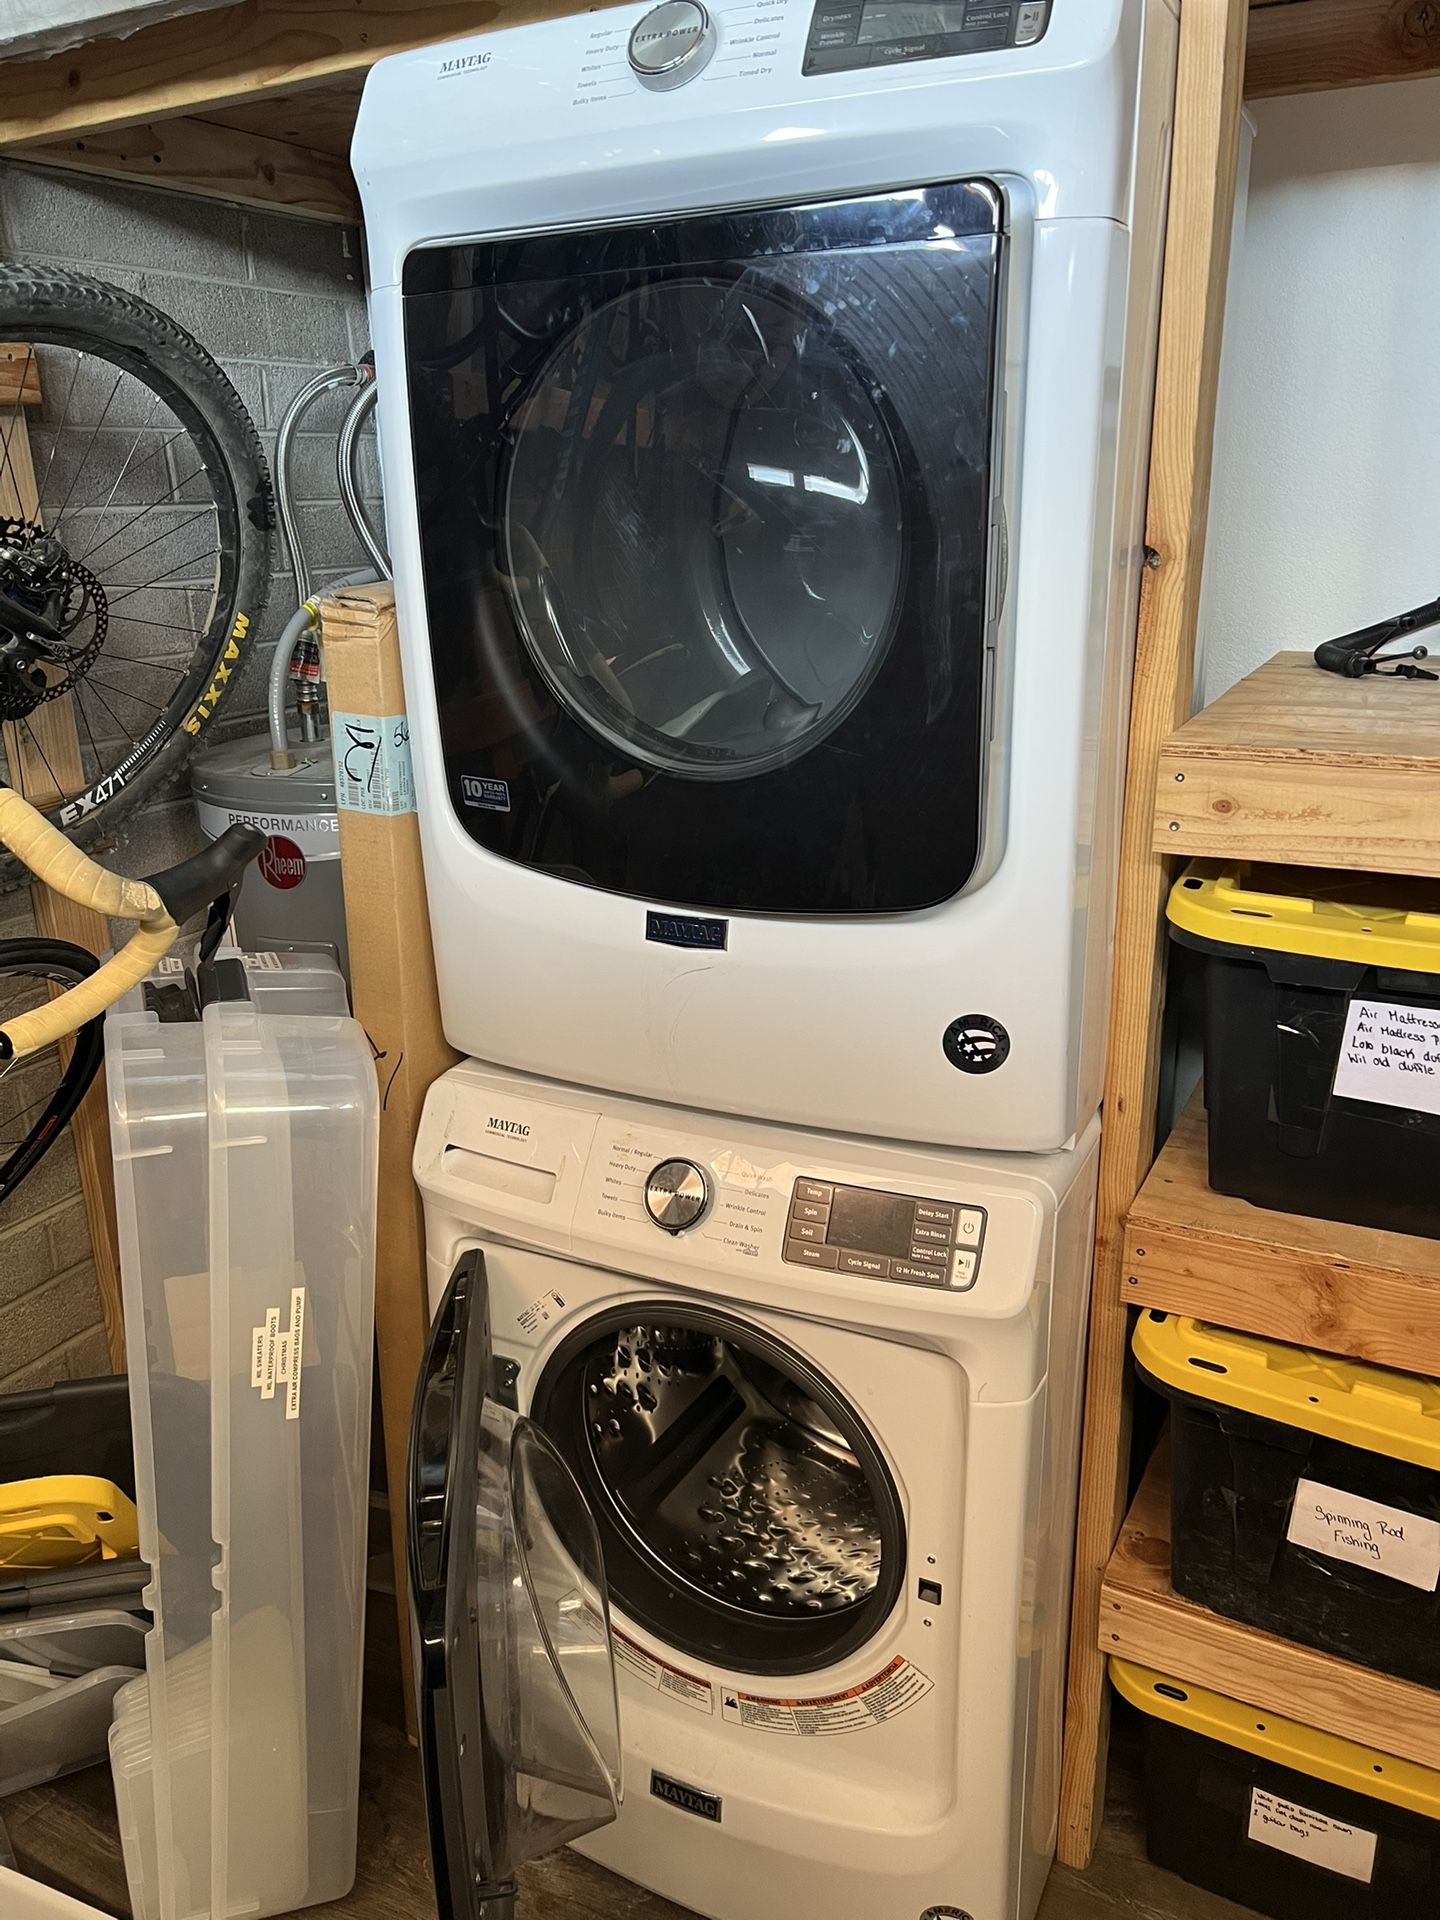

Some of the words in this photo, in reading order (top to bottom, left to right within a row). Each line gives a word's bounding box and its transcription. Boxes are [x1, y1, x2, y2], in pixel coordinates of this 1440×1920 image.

[966, 12, 992, 21] Control
[635, 32, 663, 43] EXTRA
[666, 26, 699, 38] POWER
[439, 52, 492, 74] MAYTAG
[184, 611, 250, 736] MAXXIS
[464, 779, 483, 798] 10
[482, 782, 505, 792] YEAR
[59, 769, 126, 827] EX471
[228, 813, 340, 832] PERFORMANCE
[263, 837, 304, 881] Rheem
[651, 920, 721, 941] MAYTAG
[1359, 1006, 1378, 1019] Air
[1388, 1010, 1440, 1029] Mattress
[951, 1017, 1006, 1042] AMRICA
[1357, 1021, 1373, 1033] Air
[1380, 1026, 1426, 1043] Mattress
[1381, 1043, 1415, 1060] black
[1373, 1056, 1390, 1068] old
[1398, 1061, 1436, 1075] duffle
[487, 1117, 531, 1136] MAYTAG
[612, 1145, 630, 1153] Normal
[634, 1149, 653, 1158] Regular
[608, 1161, 624, 1170] Heavy
[624, 1163, 636, 1172] Duty
[605, 1177, 622, 1185] Whites
[602, 1192, 618, 1201] Towels
[649, 1184, 672, 1194] EXTRA
[673, 1191, 701, 1202] POWER
[744, 1189, 770, 1199] Delicates
[806, 1187, 823, 1198] Temp
[597, 1208, 611, 1218] Bulky
[612, 1211, 626, 1220] Items
[725, 1202, 745, 1212] Wrinkle
[746, 1206, 767, 1216] Control
[804, 1207, 818, 1216] Spin
[918, 1208, 934, 1218] Delay
[729, 1220, 744, 1229] Drain
[750, 1225, 763, 1233] Spin
[801, 1227, 814, 1236] Soil
[915, 1228, 929, 1236] Extra
[930, 1230, 946, 1239] Rinse
[723, 1237, 739, 1246] Clean
[739, 1240, 760, 1250] Washer
[912, 1246, 933, 1255] Control
[933, 1249, 948, 1258] Lock
[803, 1249, 820, 1258] Steam
[848, 1257, 862, 1266] Cycle
[863, 1261, 881, 1270] Signal
[910, 1268, 926, 1277] Fresh
[926, 1271, 940, 1279] Spin
[267, 1339, 275, 1380] WATERPROOF
[1315, 1505, 1372, 1541] Spinning
[1376, 1520, 1405, 1541] Rod
[1334, 1529, 1381, 1560] Fishing
[655, 1779, 715, 1816] MAYTAG
[1262, 1814, 1286, 1824] guitar
[1289, 1823, 1309, 1838] bags
